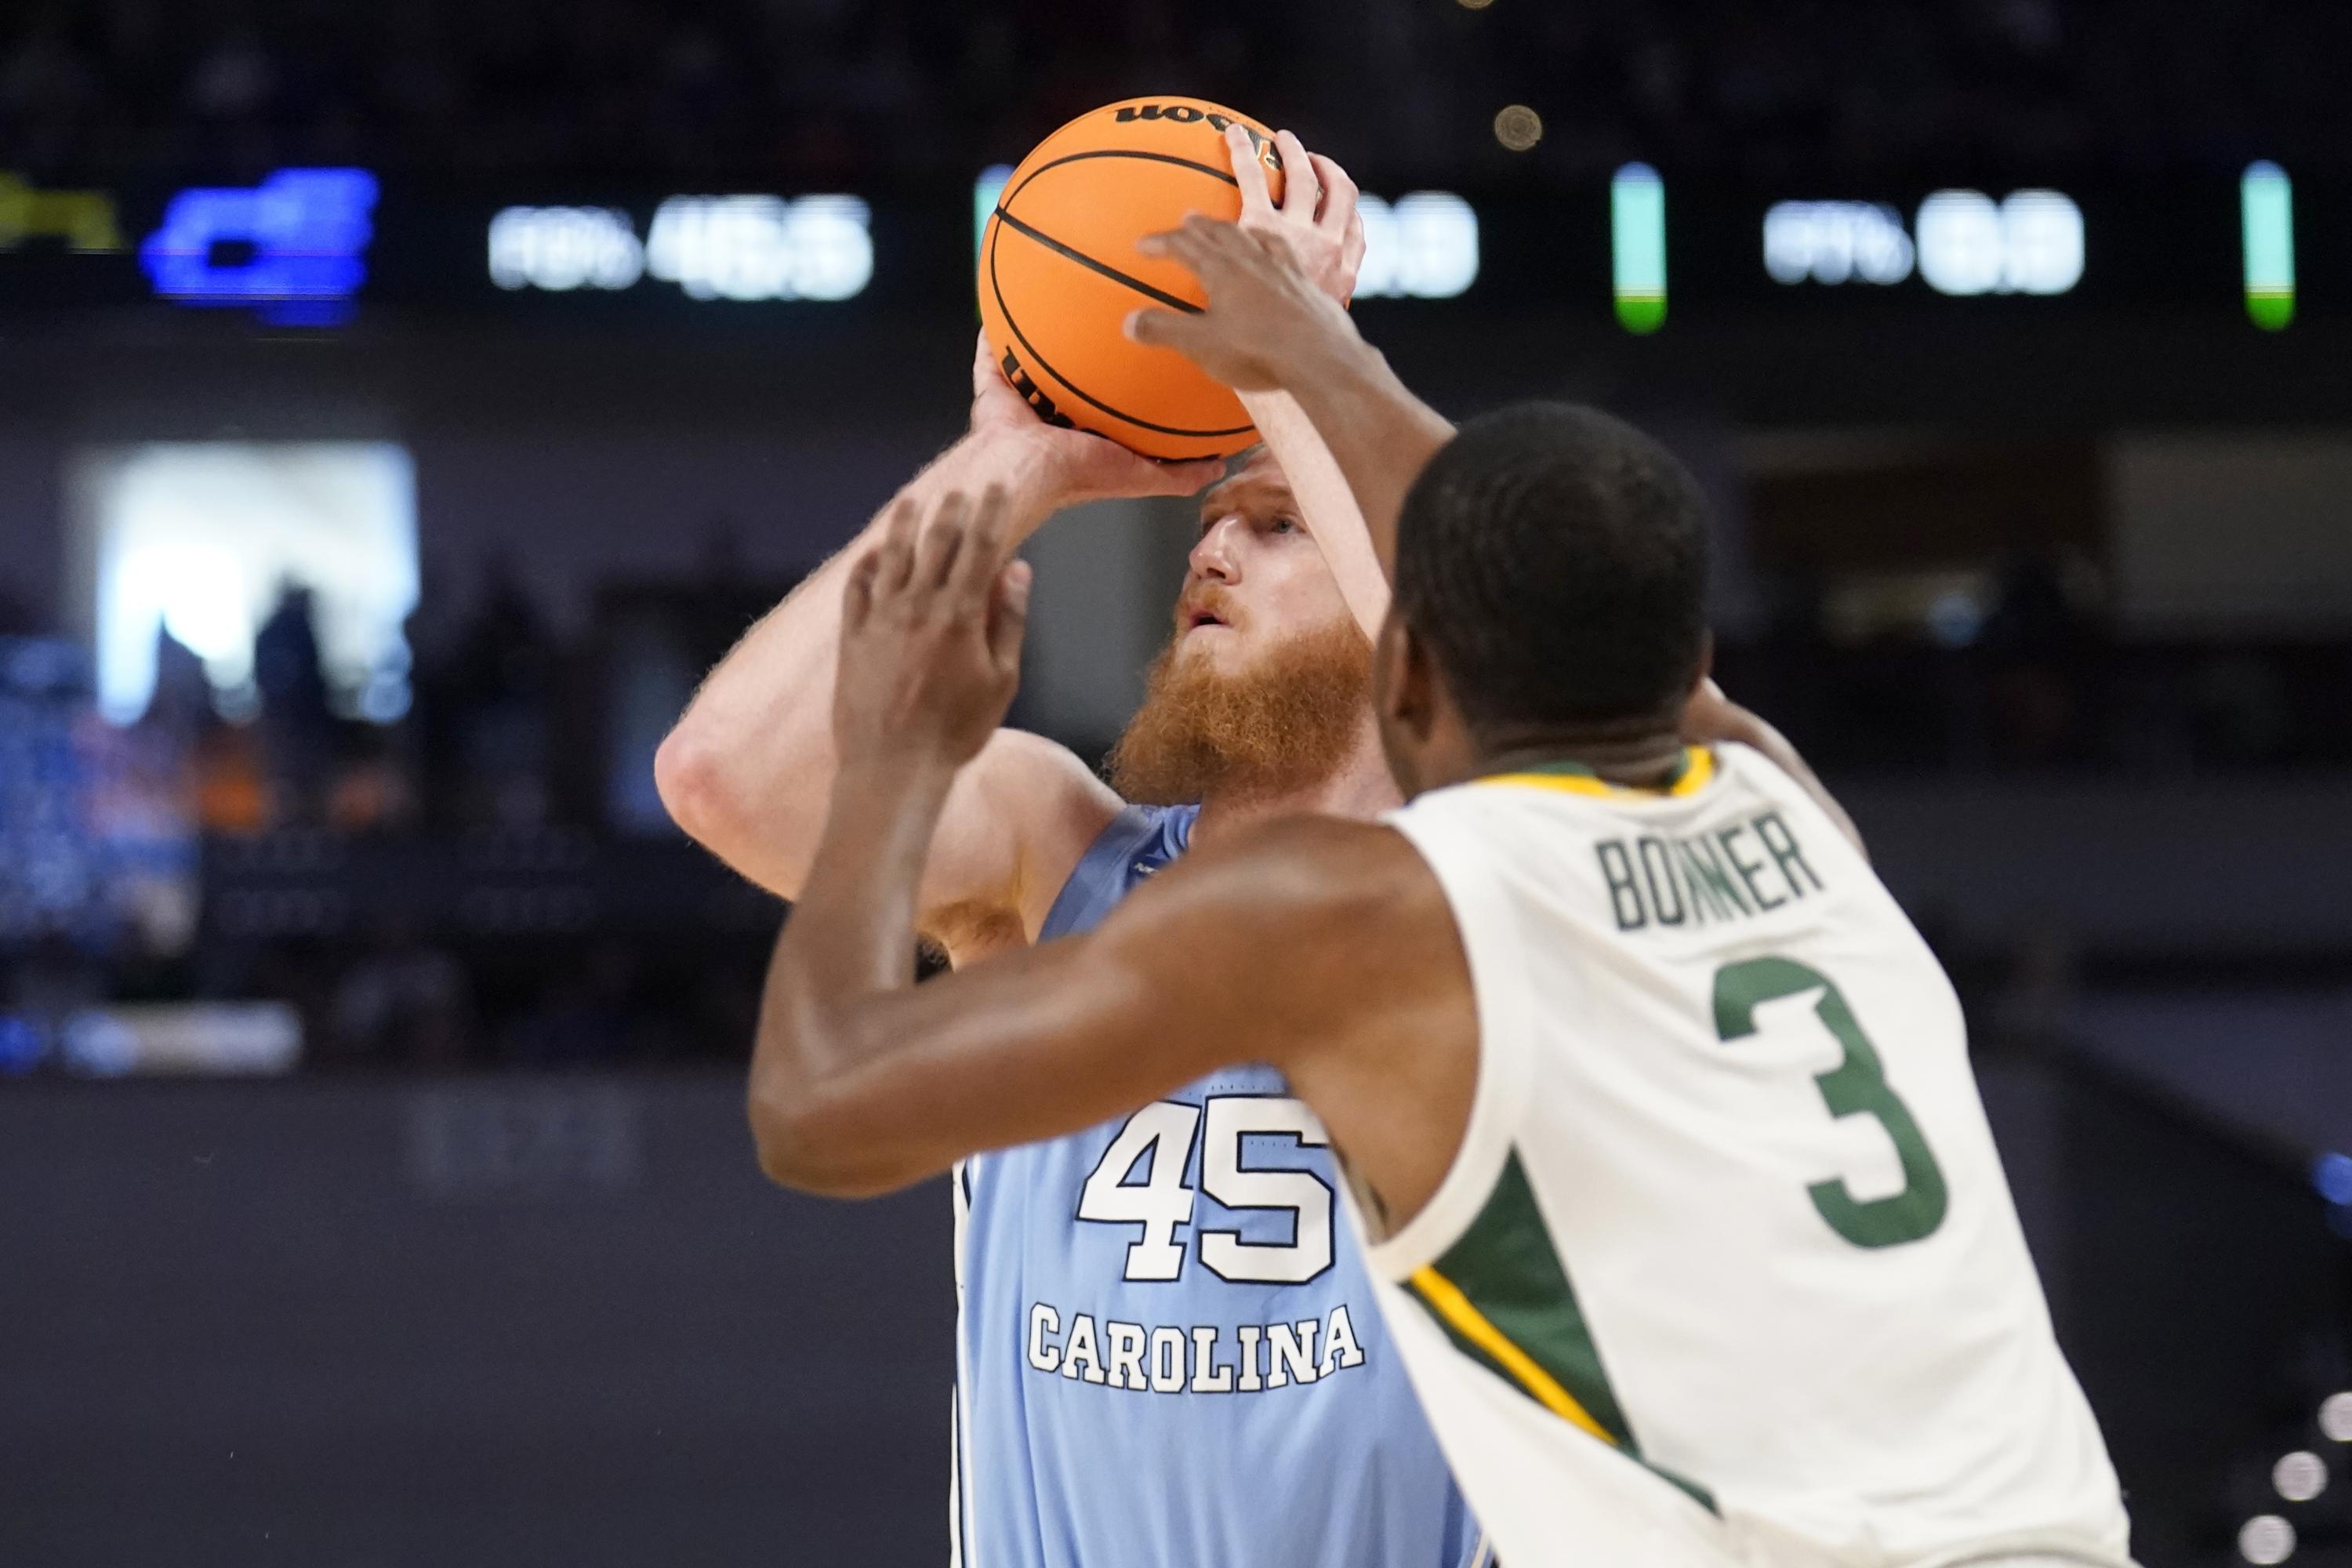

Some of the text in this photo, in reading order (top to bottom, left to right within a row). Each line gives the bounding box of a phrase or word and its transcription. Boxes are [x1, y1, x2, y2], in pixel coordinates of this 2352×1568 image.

[1594, 811, 1826, 932] BONNER
[1712, 953, 1950, 1250] 3
[1076, 1093, 1336, 1285] 45
[1027, 1301, 1366, 1395] CAROLINA
